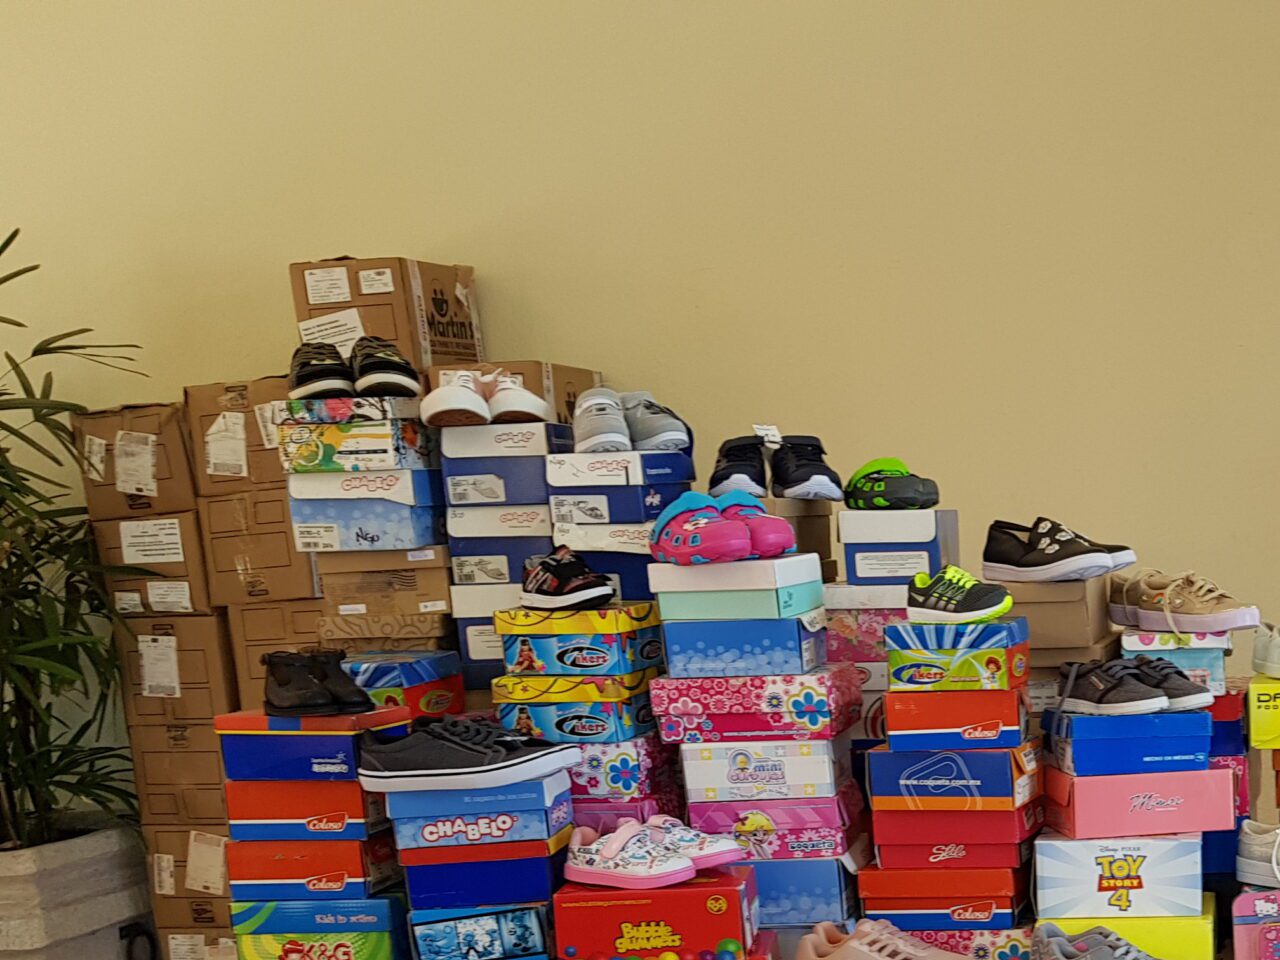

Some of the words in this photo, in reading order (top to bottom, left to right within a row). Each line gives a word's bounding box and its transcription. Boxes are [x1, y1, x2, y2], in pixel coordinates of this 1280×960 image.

[309, 818, 343, 831] Coloso
[421, 814, 515, 843] CHABELO
[1095, 854, 1148, 879] TOY
[308, 877, 343, 890] Coloso
[1101, 877, 1140, 888] STORY
[1108, 888, 1132, 912] 4
[953, 906, 989, 920] Coloso
[620, 920, 673, 939] Bubble
[615, 933, 683, 953] gummers
